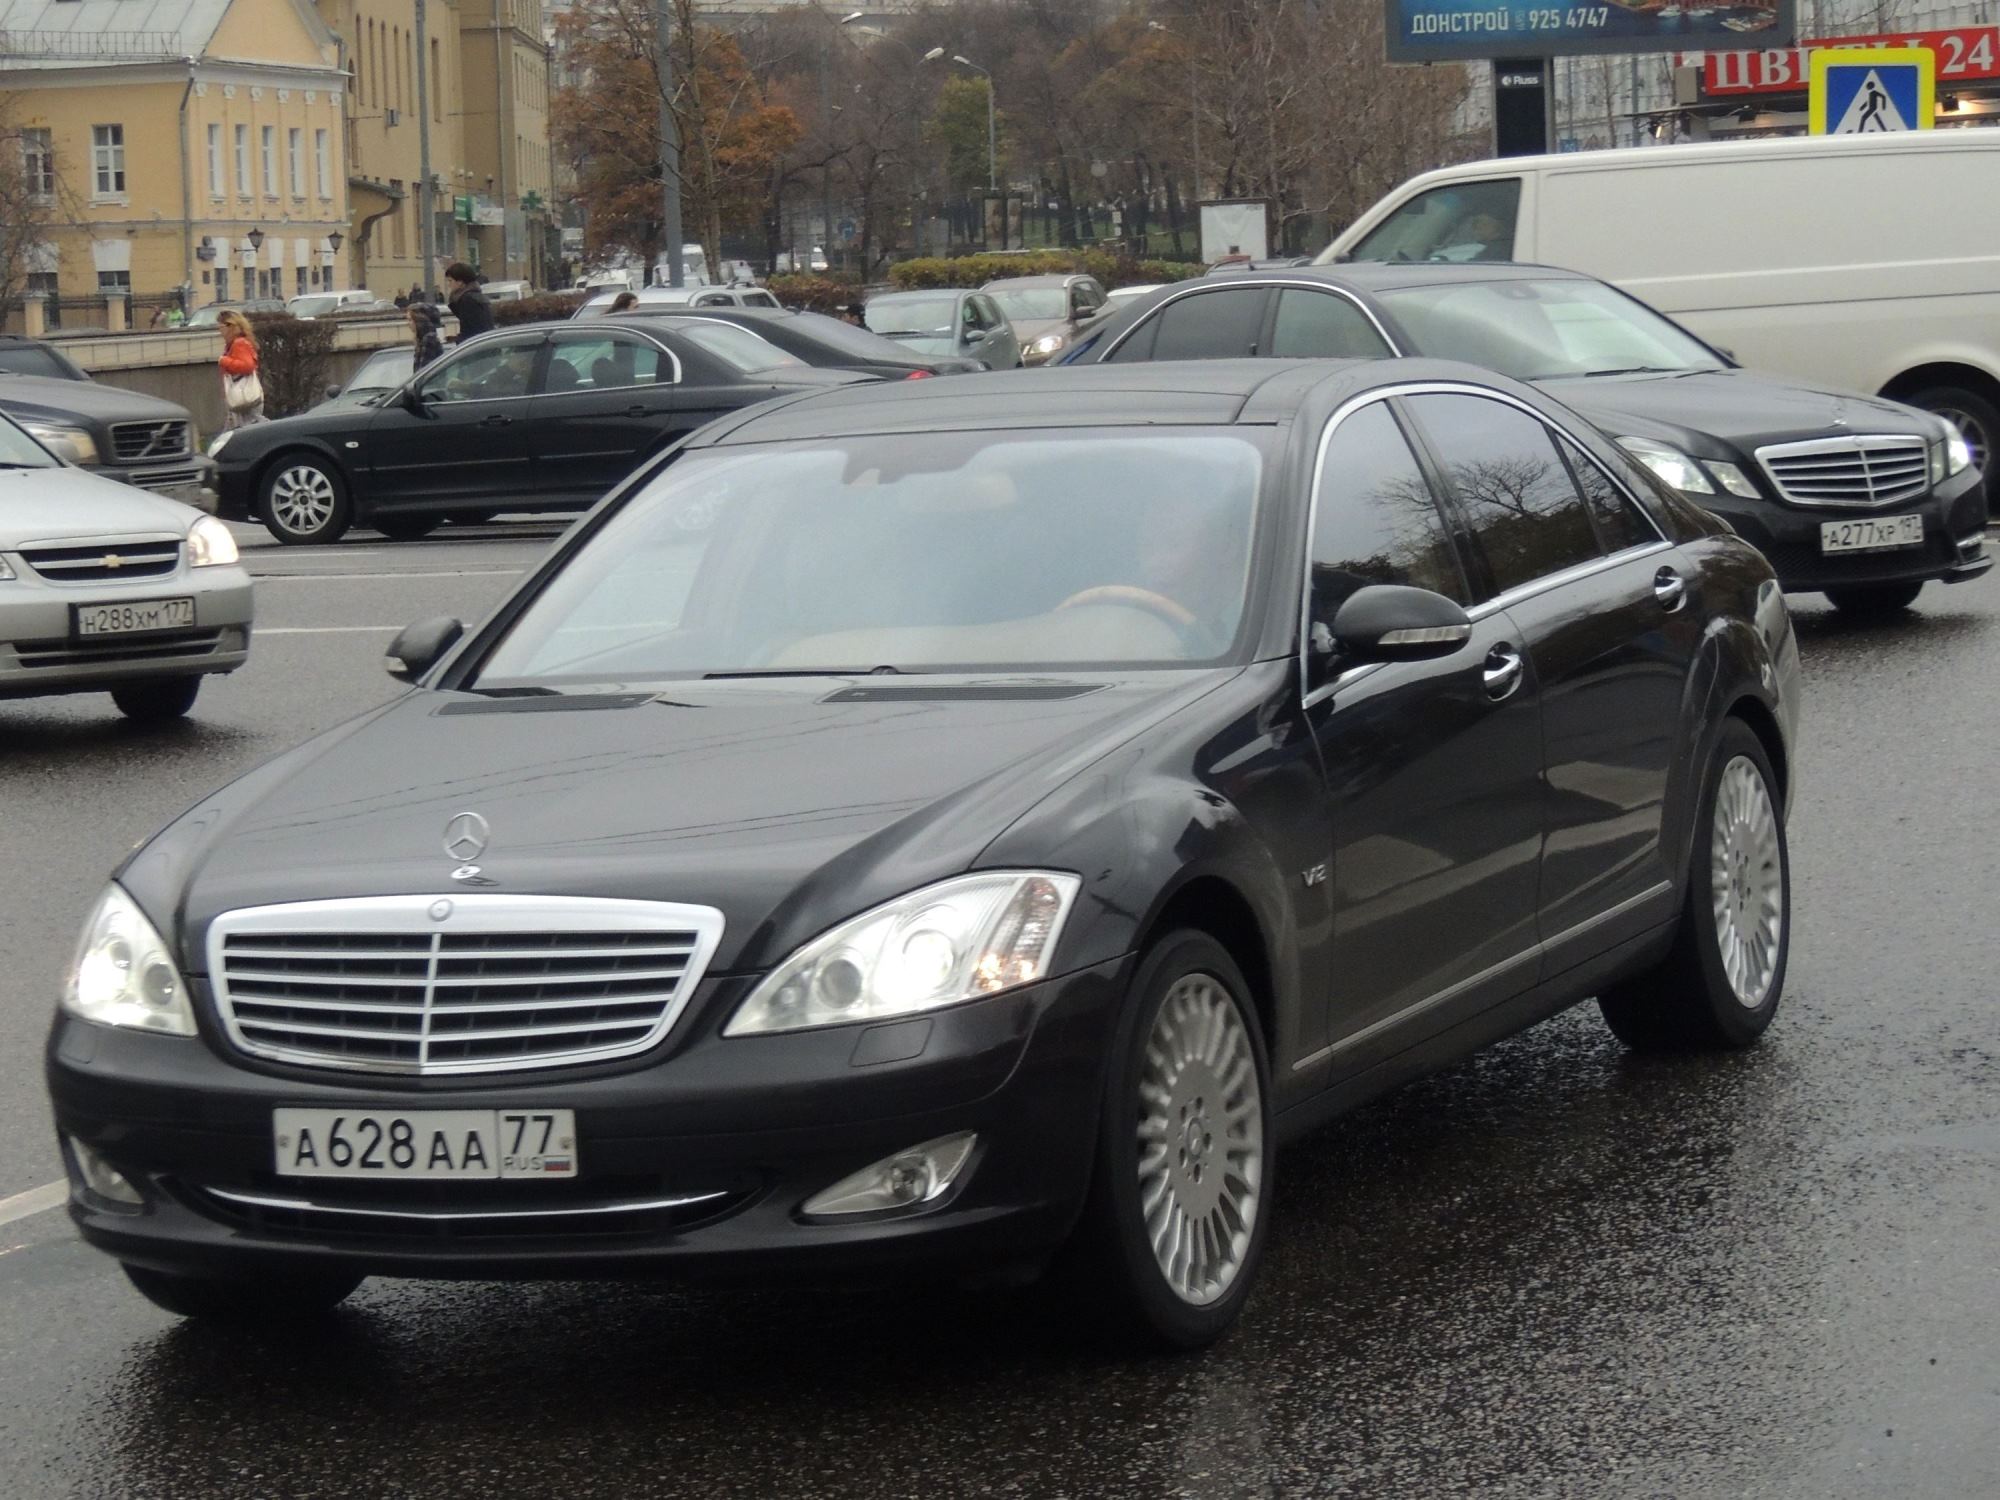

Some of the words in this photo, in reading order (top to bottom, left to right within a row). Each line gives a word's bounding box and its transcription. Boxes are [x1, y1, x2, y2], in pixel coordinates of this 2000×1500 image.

[1411, 7, 1509, 34] ДОНСТРОЙ
[1529, 9, 1560, 30] 925
[1566, 7, 1608, 29] 4747
[1940, 33, 1994, 75] 24
[1513, 75, 1539, 86] Russ
[1828, 521, 1895, 547] А277ХР
[84, 607, 160, 634] Н288ХМ
[162, 600, 190, 619] 177
[295, 1116, 489, 1170] А628АА
[504, 1114, 555, 1155] 77
[503, 1156, 543, 1171] RUS
